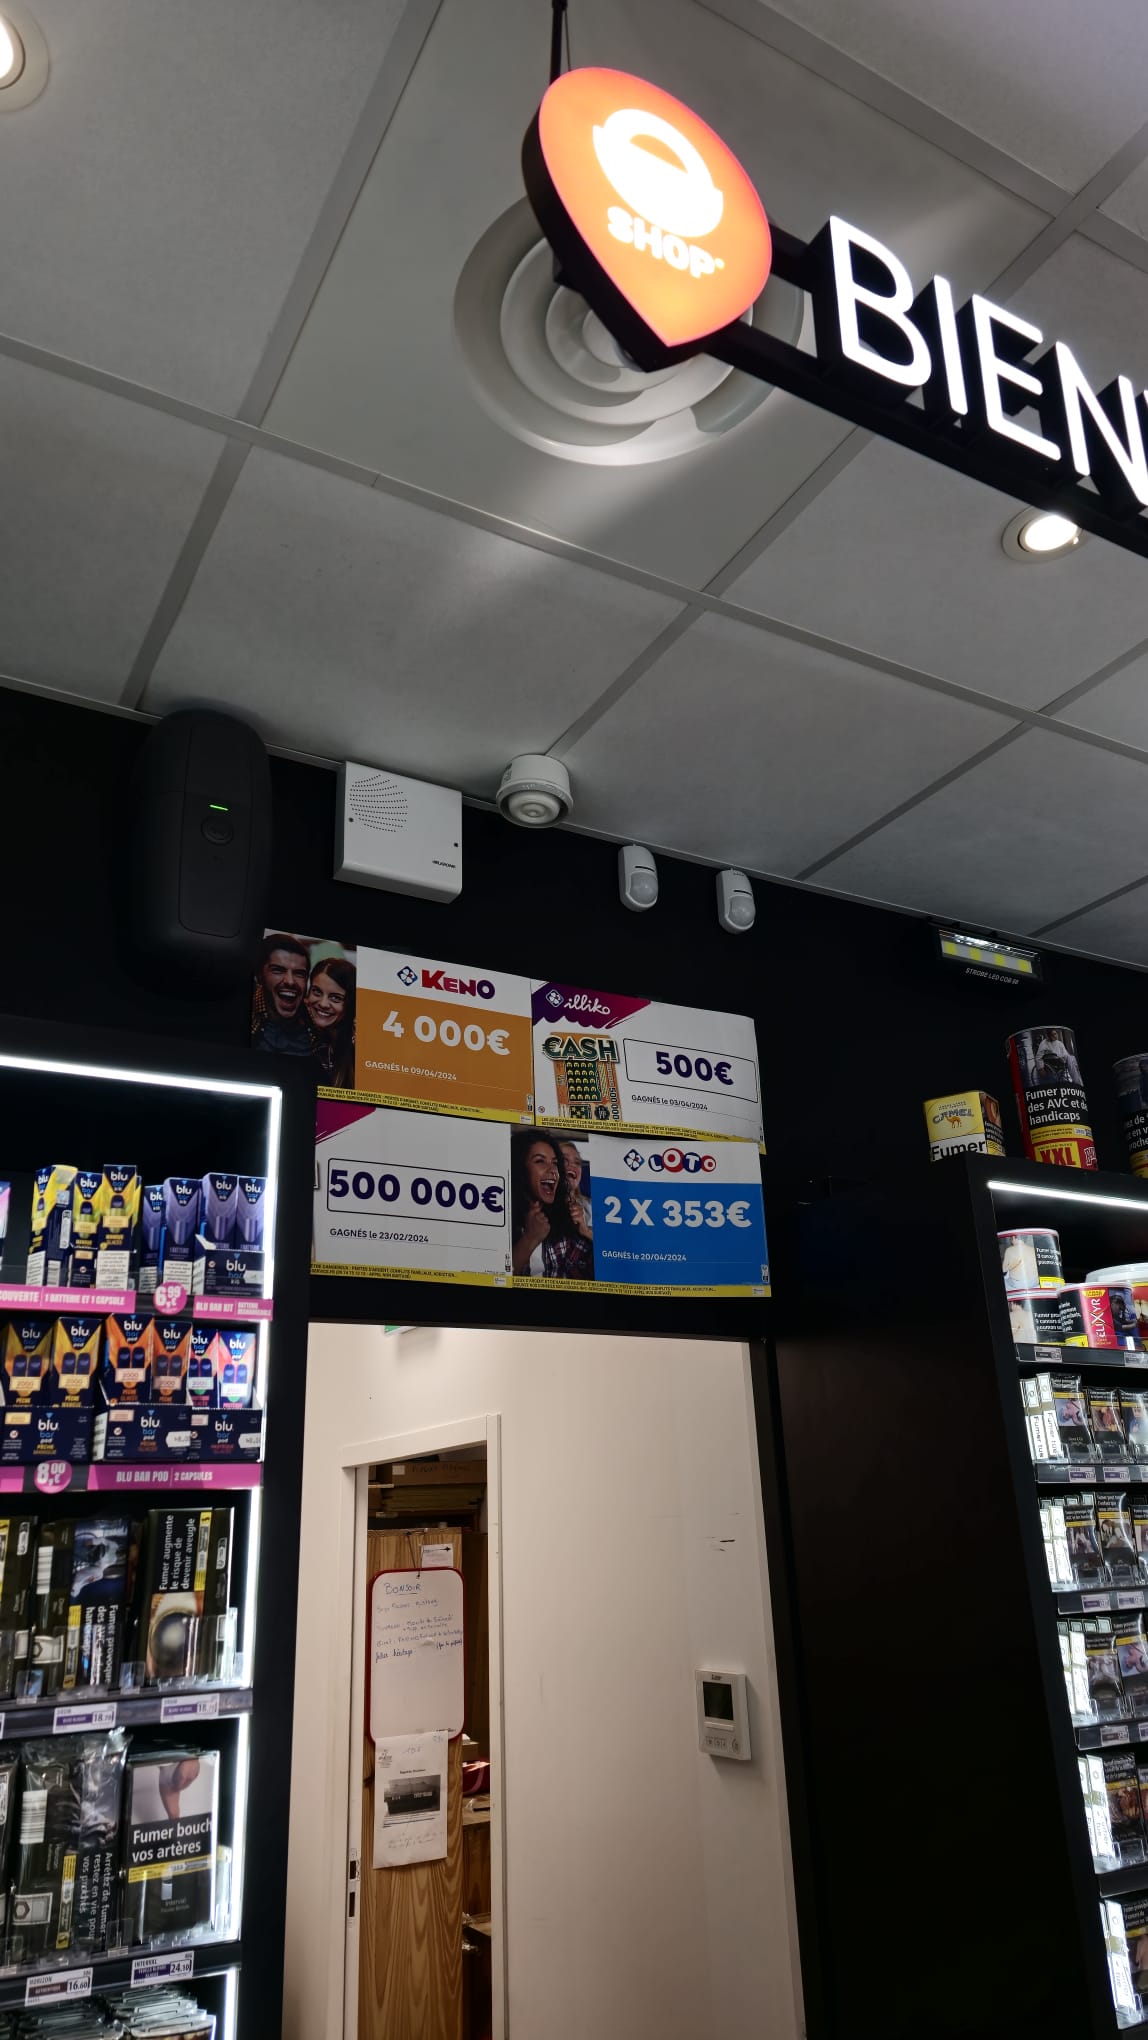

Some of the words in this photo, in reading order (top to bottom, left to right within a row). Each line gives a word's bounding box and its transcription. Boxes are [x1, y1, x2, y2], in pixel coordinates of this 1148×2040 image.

[606, 205, 716, 279] SHOP
[830, 216, 1148, 508] BIEN
[421, 969, 495, 999] KENO
[564, 994, 611, 1015] illiko
[382, 1011, 404, 1037] 4
[414, 1015, 510, 1056] 000€
[365, 1060, 400, 1073] GAGNÉS
[402, 1064, 409, 1073] le
[410, 1066, 457, 1081] 09/04/2024
[655, 1050, 734, 1086] 500€
[1025, 1087, 1058, 1101] Fumer
[631, 1095, 659, 1104] GAGNÉS
[669, 1098, 708, 1111] 03/04/2024
[1028, 1103, 1045, 1113] des
[1047, 1097, 1070, 1109] AVC
[933, 1108, 974, 1124] CAMEL
[1029, 1111, 1081, 1126] handicaps
[930, 1140, 986, 1160] Fumer
[648, 1147, 716, 1173] LOTO
[80, 1177, 97, 1188] blu
[111, 1171, 128, 1181] blu
[176, 1185, 192, 1195] blu
[216, 1180, 232, 1190] blu
[245, 1183, 261, 1193] blu
[329, 1169, 400, 1202] 500
[411, 1177, 504, 1213] 000€
[604, 1196, 622, 1224] 2
[629, 1198, 655, 1226] X
[662, 1200, 752, 1228] 353€
[329, 1228, 367, 1238] GAGNÉS
[369, 1231, 377, 1239] le
[379, 1232, 429, 1243] 23/02/2024
[602, 1250, 631, 1260] GAGNÉS
[632, 1252, 639, 1260] le
[640, 1252, 687, 1262] 20/04/2024
[226, 1259, 247, 1272] blu
[22, 1328, 41, 1338] blu
[71, 1325, 90, 1336] blu
[124, 1321, 142, 1331] blu
[163, 1329, 181, 1339] blu
[191, 1335, 208, 1345] blu
[229, 1339, 245, 1349] blu
[38, 1418, 59, 1431] blu
[140, 1416, 161, 1428] blu
[215, 1421, 234, 1432] blu
[116, 1471, 132, 1482] BLU
[134, 1471, 151, 1482] BAR
[152, 1471, 169, 1482] POD
[174, 1471, 179, 1481] 2
[180, 1471, 213, 1481] CAPSULES
[163, 1514, 174, 1560] augmente
[174, 1537, 183, 1549] de
[185, 1518, 197, 1553] aveugle
[170, 1551, 182, 1579] risque
[159, 1562, 170, 1591] Fumer
[181, 1556, 192, 1590] devenir
[169, 1580, 179, 1590] le
[107, 1604, 118, 1635] Fumer
[133, 1827, 174, 1845] Fumer
[132, 1849, 154, 1863] vos
[156, 1841, 201, 1859] artères
[92, 1853, 101, 1885] restez
[91, 1885, 99, 1898] en
[90, 1900, 99, 1916] vie
[134, 1959, 157, 1968] INTERVAL
